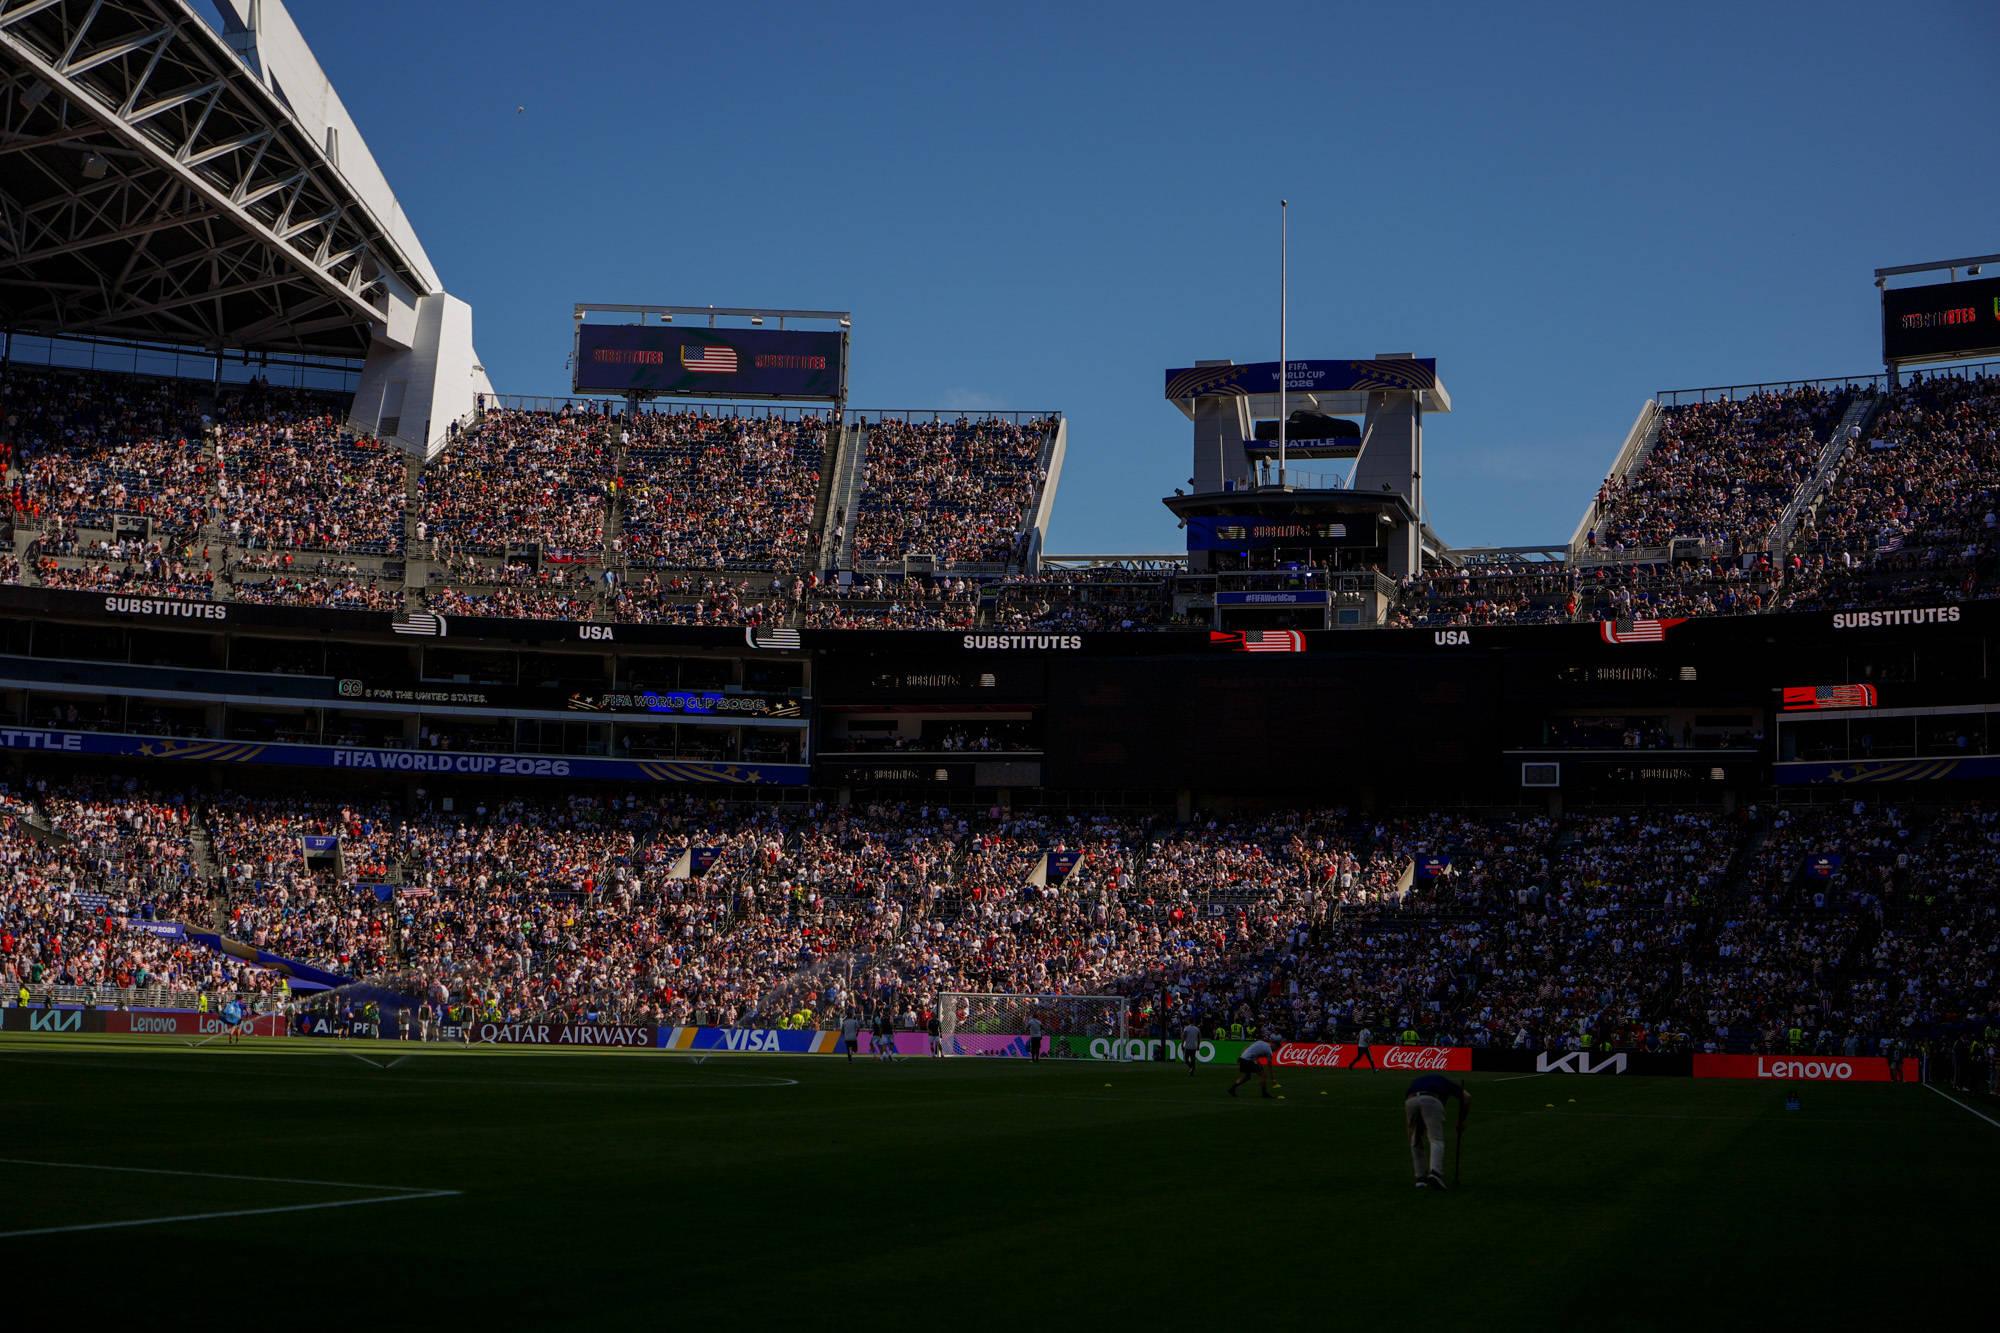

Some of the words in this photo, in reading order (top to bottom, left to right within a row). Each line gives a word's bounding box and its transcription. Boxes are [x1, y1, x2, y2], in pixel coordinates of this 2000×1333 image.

[1271, 371, 1306, 380] WRLD
[1306, 370, 1326, 379] CUP
[1288, 362, 1308, 371] FIFA
[1245, 594, 1297, 603] #FIFAWorldCup
[104, 597, 227, 620] SUBSTITUTES
[1832, 606, 1961, 629] SUBSTITUTES
[579, 625, 614, 640] USA
[1434, 630, 1470, 645] USA
[963, 635, 1082, 649] SUBSTITUTES
[395, 690, 414, 700] THE
[601, 694, 633, 706] FIFA
[634, 694, 684, 708] WORLD
[686, 697, 716, 709] CUP
[0, 730, 82, 751] TTLE
[333, 750, 376, 768] FIFA
[379, 752, 453, 771] WORLD
[455, 755, 497, 773] CUP
[499, 757, 571, 777] 2026
[130, 1012, 177, 1033] Lenovo
[480, 1023, 550, 1044] QATAR
[559, 1025, 648, 1046] AIRWAYS
[721, 1028, 780, 1051] VISA
[1757, 1056, 1853, 1080] Lenovo
